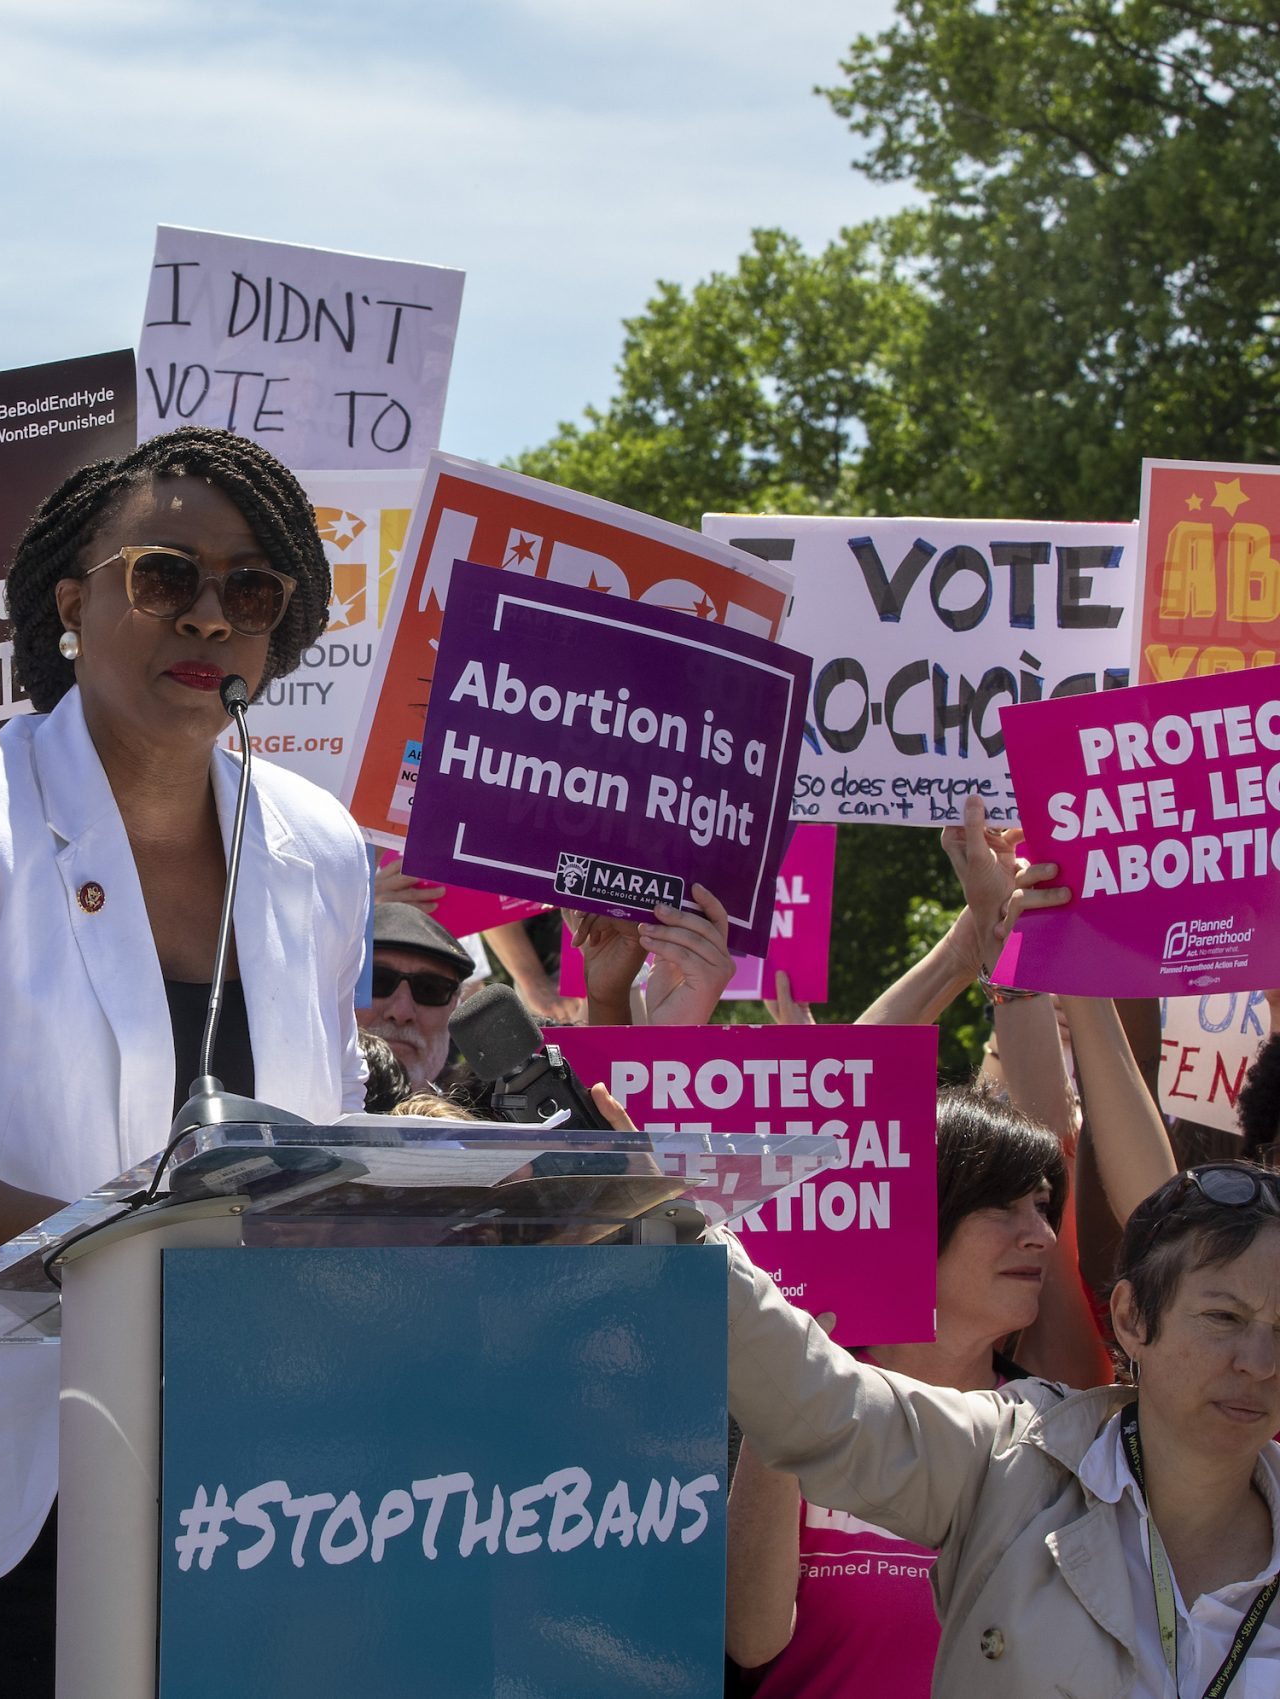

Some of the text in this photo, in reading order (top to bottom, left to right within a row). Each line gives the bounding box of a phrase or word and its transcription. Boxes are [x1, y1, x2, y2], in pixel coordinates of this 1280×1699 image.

[146, 262, 433, 365] I DIDN'T
[146, 362, 411, 453] VOTE TO
[847, 535, 1125, 633] VOTE
[449, 659, 767, 777] Abortion is a
[438, 730, 755, 847] Human Right
[831, 766, 886, 798] does
[891, 775, 999, 808] everyone
[838, 798, 914, 819] can't
[930, 796, 960, 821] be
[1047, 778, 1196, 842] SAFE,
[591, 886, 638, 901] PRO-CHOICE
[593, 867, 675, 900] NARAL
[1187, 927, 1253, 948] Parenthood
[1189, 915, 1234, 934] Planned
[611, 1058, 873, 1110] PROTECT
